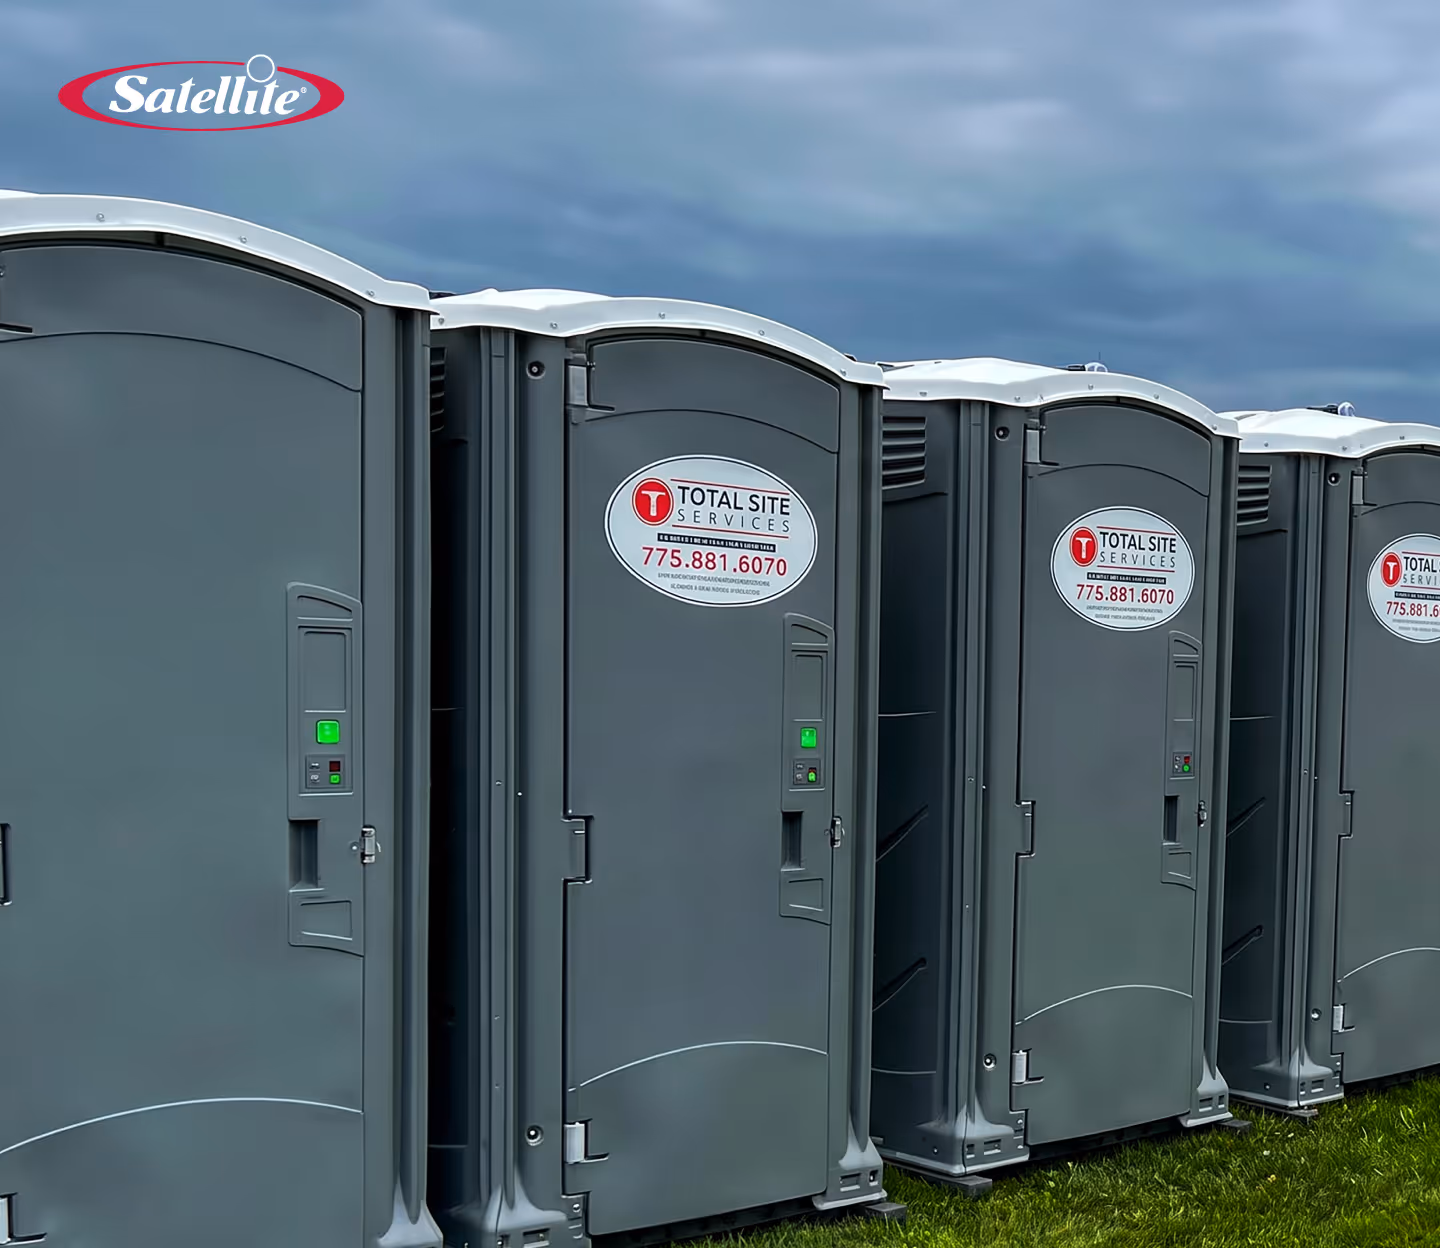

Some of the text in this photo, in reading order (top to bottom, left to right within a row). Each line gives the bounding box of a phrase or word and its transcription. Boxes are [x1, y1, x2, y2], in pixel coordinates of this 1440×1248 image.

[641, 490, 666, 517] T
[677, 485, 790, 516] TOTAL SITE
[677, 508, 790, 533] SERVICES
[1075, 537, 1092, 559] T
[1099, 531, 1177, 554] TOTAL SITE
[642, 546, 787, 577] 775.881.6070
[1099, 551, 1176, 568] SERVICES
[1403, 556, 1437, 573] TOTAL
[1386, 562, 1398, 580] T
[1076, 583, 1175, 605] 775.881.6070
